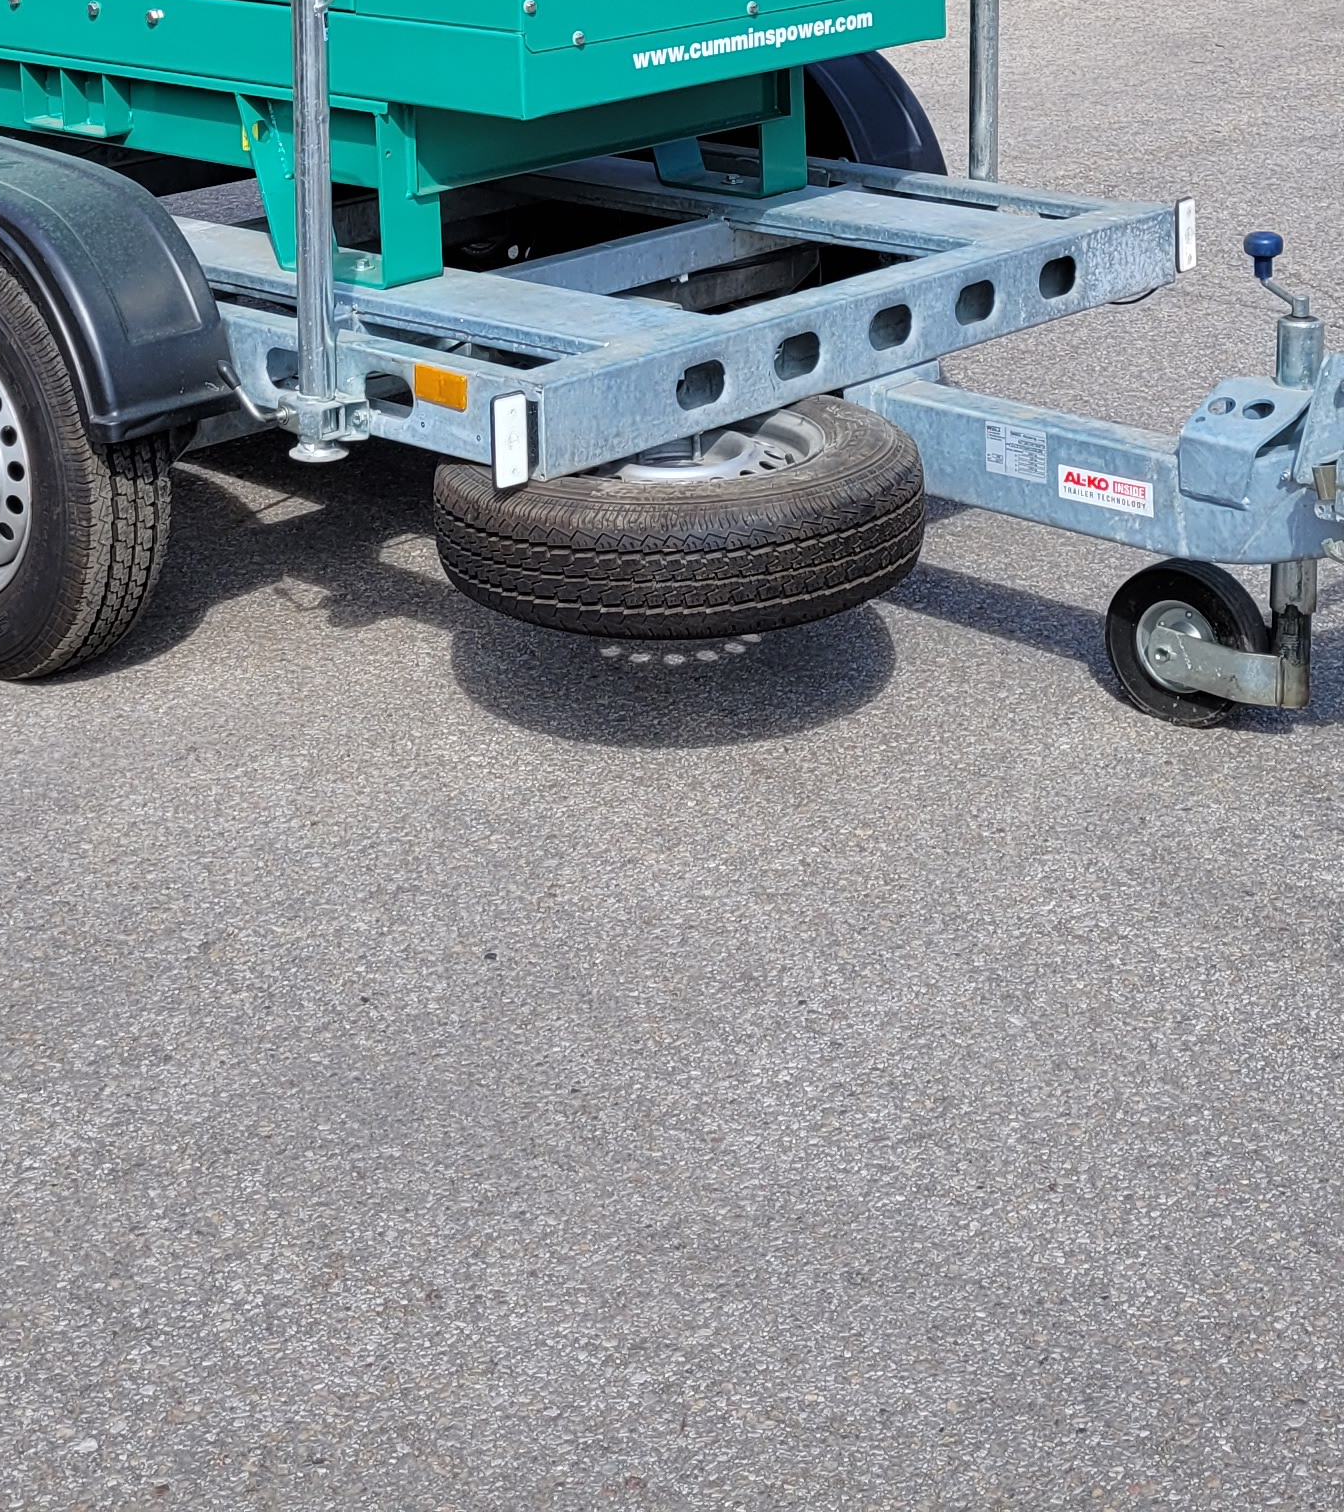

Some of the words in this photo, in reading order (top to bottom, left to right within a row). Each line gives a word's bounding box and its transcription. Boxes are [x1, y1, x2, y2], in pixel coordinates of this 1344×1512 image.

[632, 11, 874, 70] www.cumminspower.com
[1063, 470, 1109, 492] AL-KO
[1113, 481, 1145, 499] INSIDE
[1063, 485, 1094, 499] TRAILER
[1097, 492, 1147, 510] TECHNOLOGY
